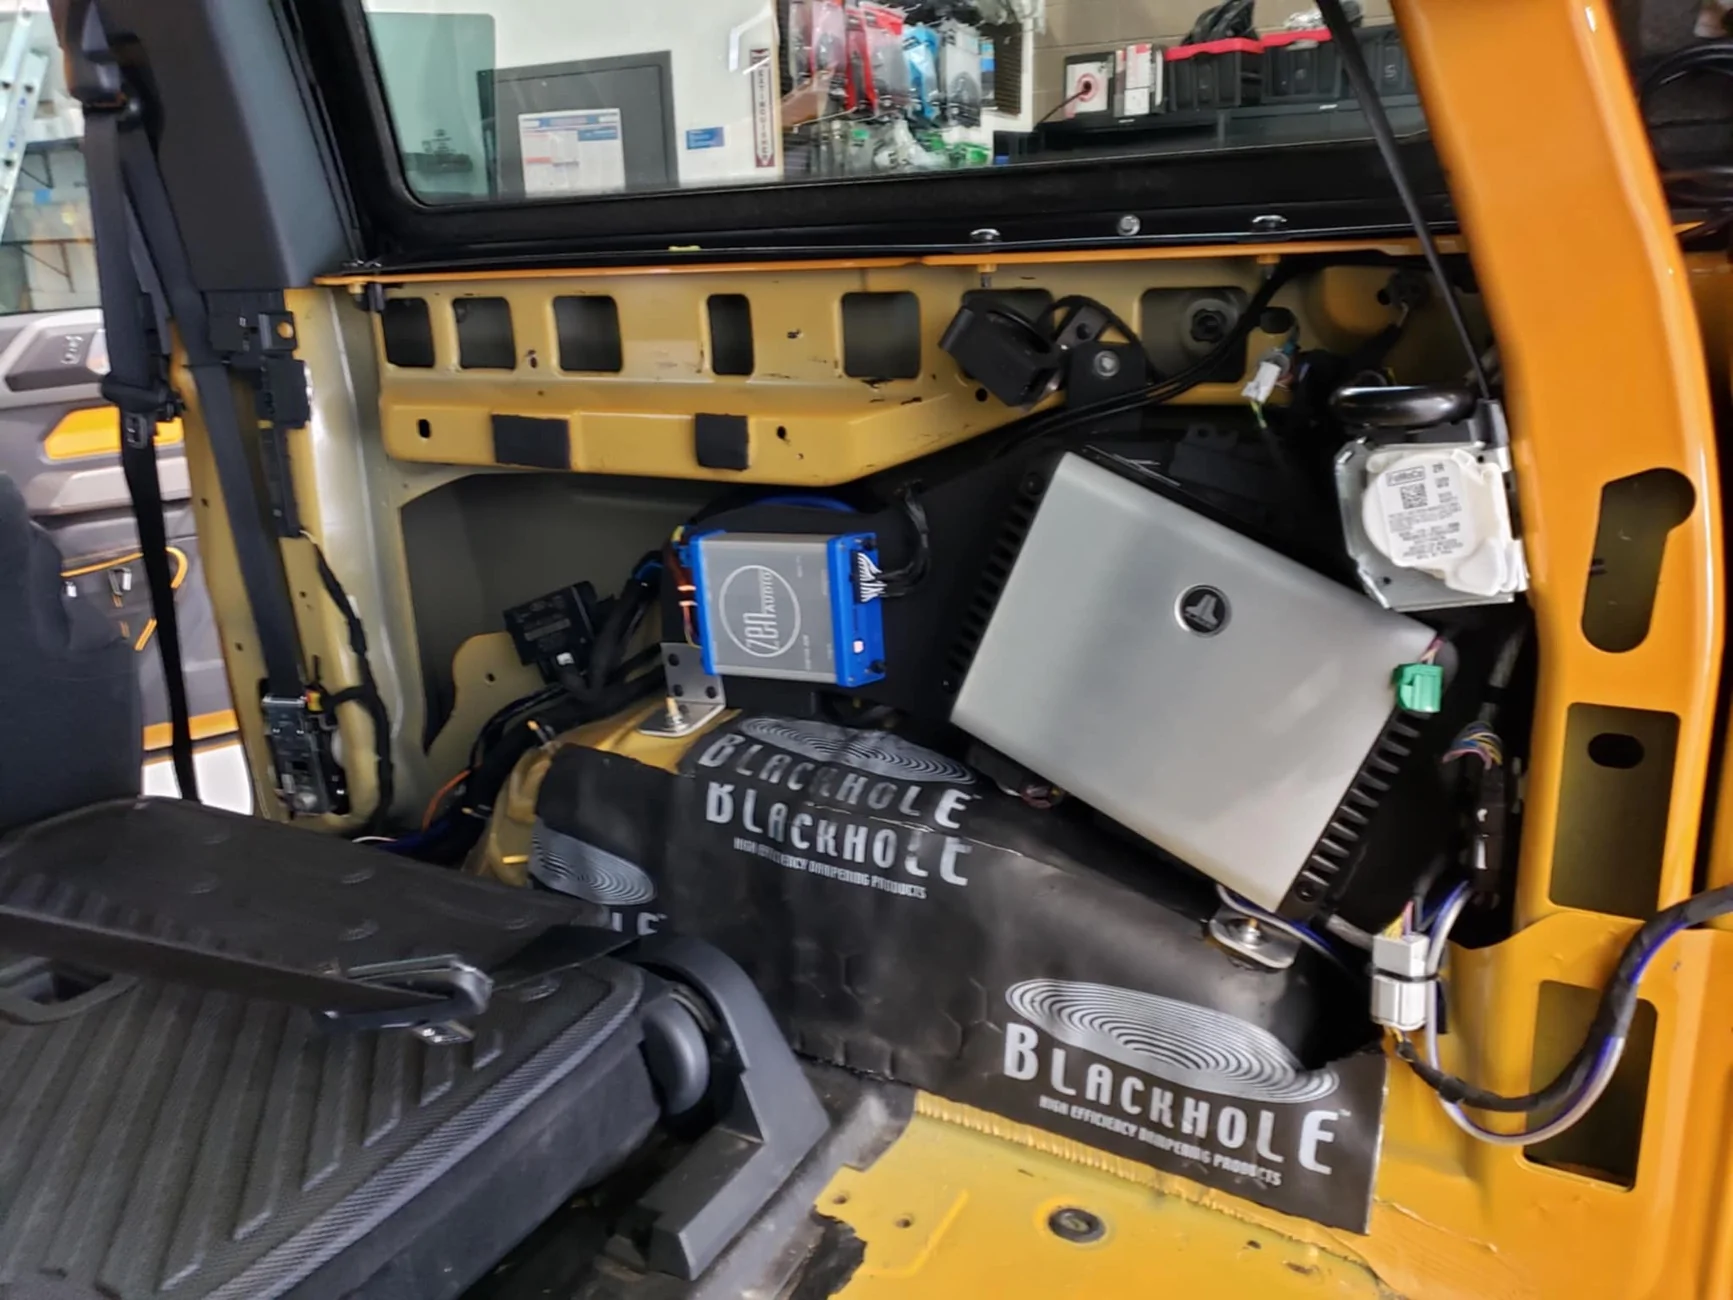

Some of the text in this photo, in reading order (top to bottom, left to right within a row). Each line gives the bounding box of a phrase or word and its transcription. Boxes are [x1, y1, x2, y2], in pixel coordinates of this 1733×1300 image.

[764, 572, 776, 613] AUDIO
[698, 733, 974, 829] BLACKHOLE
[733, 837, 756, 854] HIGH
[808, 859, 870, 887] DAMPENING
[871, 874, 928, 900] PRODUCTS
[1004, 1022, 1340, 1176] BLACKHOLE
[1039, 1094, 1282, 1187] HIGH EFFICIENCY DAMPENING PRODUCTS
